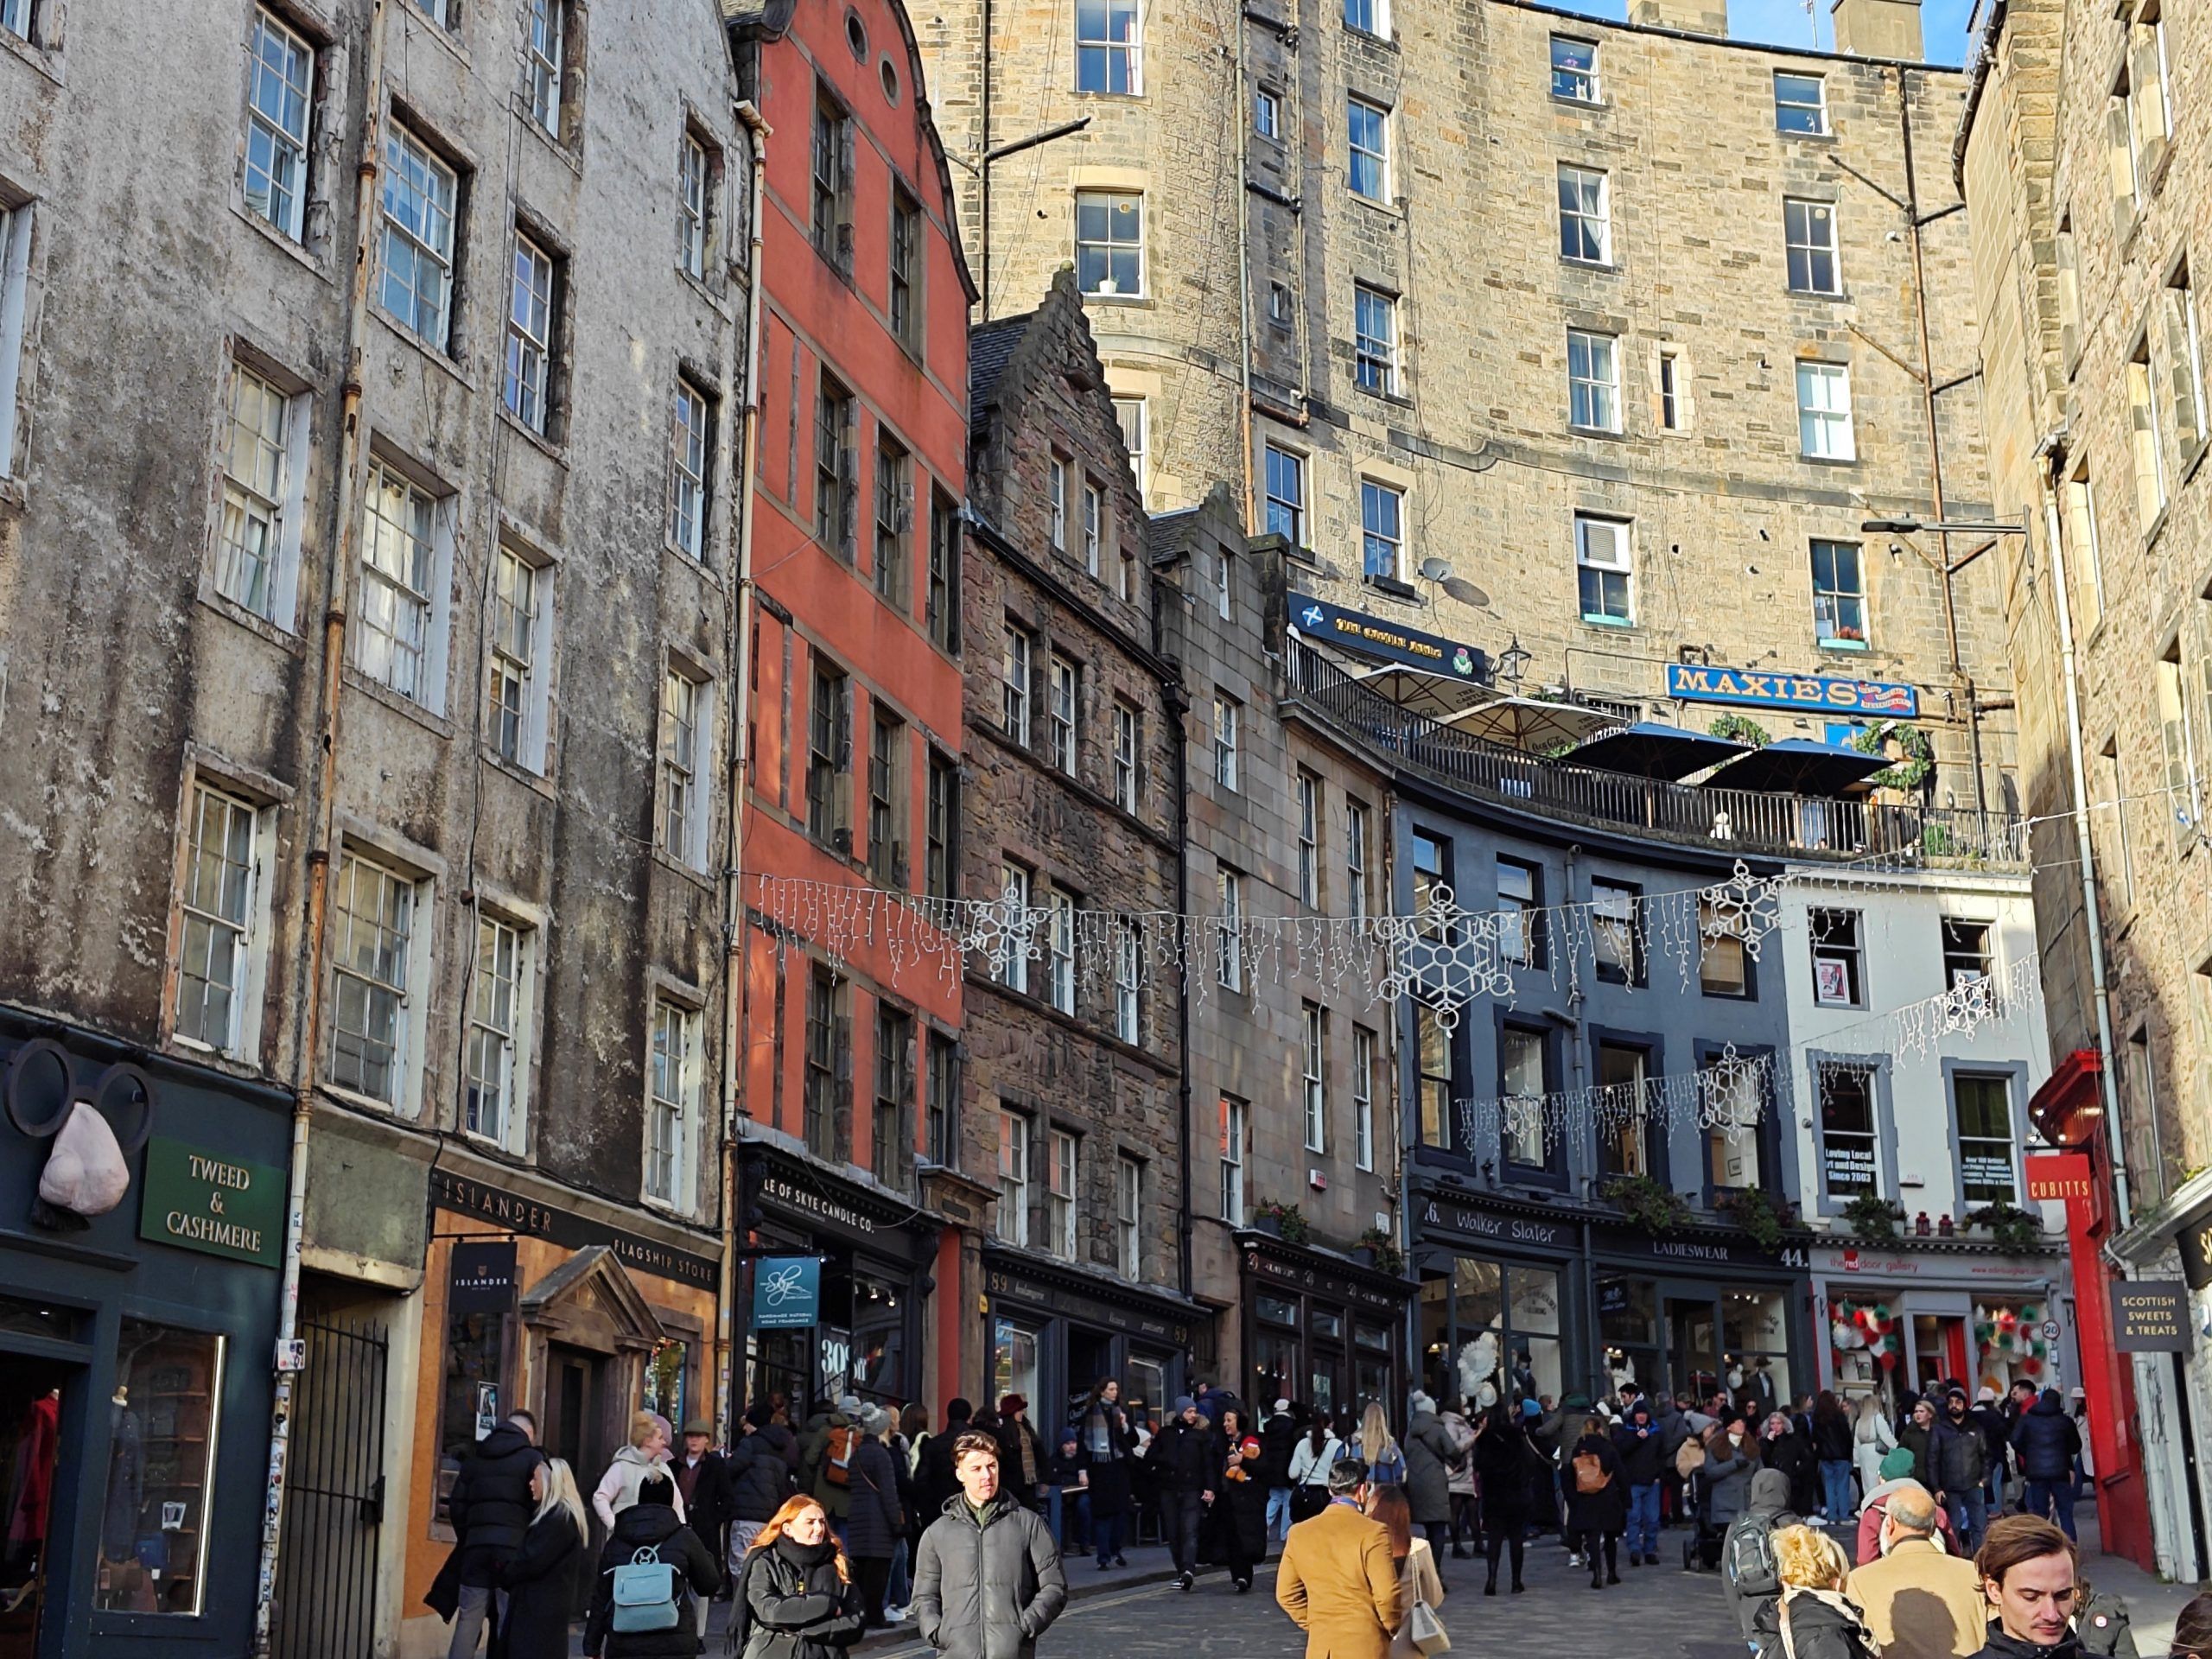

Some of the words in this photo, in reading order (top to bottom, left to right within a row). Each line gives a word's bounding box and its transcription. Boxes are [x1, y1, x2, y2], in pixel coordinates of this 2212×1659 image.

[1825, 1148, 1850, 1160] Loving
[1852, 1150, 1872, 1160] Local
[189, 1155, 250, 1191] TWEED
[1828, 1171, 1850, 1181] Since
[1851, 1173, 1872, 1182] 2003
[2031, 1180, 2088, 1198] CUBITTS
[210, 1192, 225, 1215] &
[443, 1179, 551, 1232] ISLANDER
[779, 1184, 791, 1198] OF
[795, 1190, 818, 1211] SKYE
[822, 1201, 856, 1226] CANDLE
[860, 1217, 874, 1234] CO.
[167, 1211, 261, 1252] CASHMERE
[1457, 1211, 1502, 1235] Walker
[1512, 1220, 1555, 1243] Slater
[1653, 1241, 1728, 1261] LADIESWEAR
[614, 1239, 672, 1269] FLAGSHIP
[678, 1260, 711, 1282] STORE
[1830, 1258, 1844, 1268] the
[1845, 1258, 1859, 1268] red
[1860, 1260, 1881, 1268] door
[1886, 1259, 1917, 1273] gallery
[455, 1278, 508, 1287] ISLANDER
[991, 1272, 1007, 1292] 89
[2121, 1297, 2177, 1306] SCOTTISH
[2128, 1312, 2172, 1321] SWEETS
[1173, 1325, 1187, 1343] 89
[2044, 1325, 2058, 1335] 20
[2126, 1326, 2134, 1335] &
[2138, 1325, 2177, 1335] TREATS
